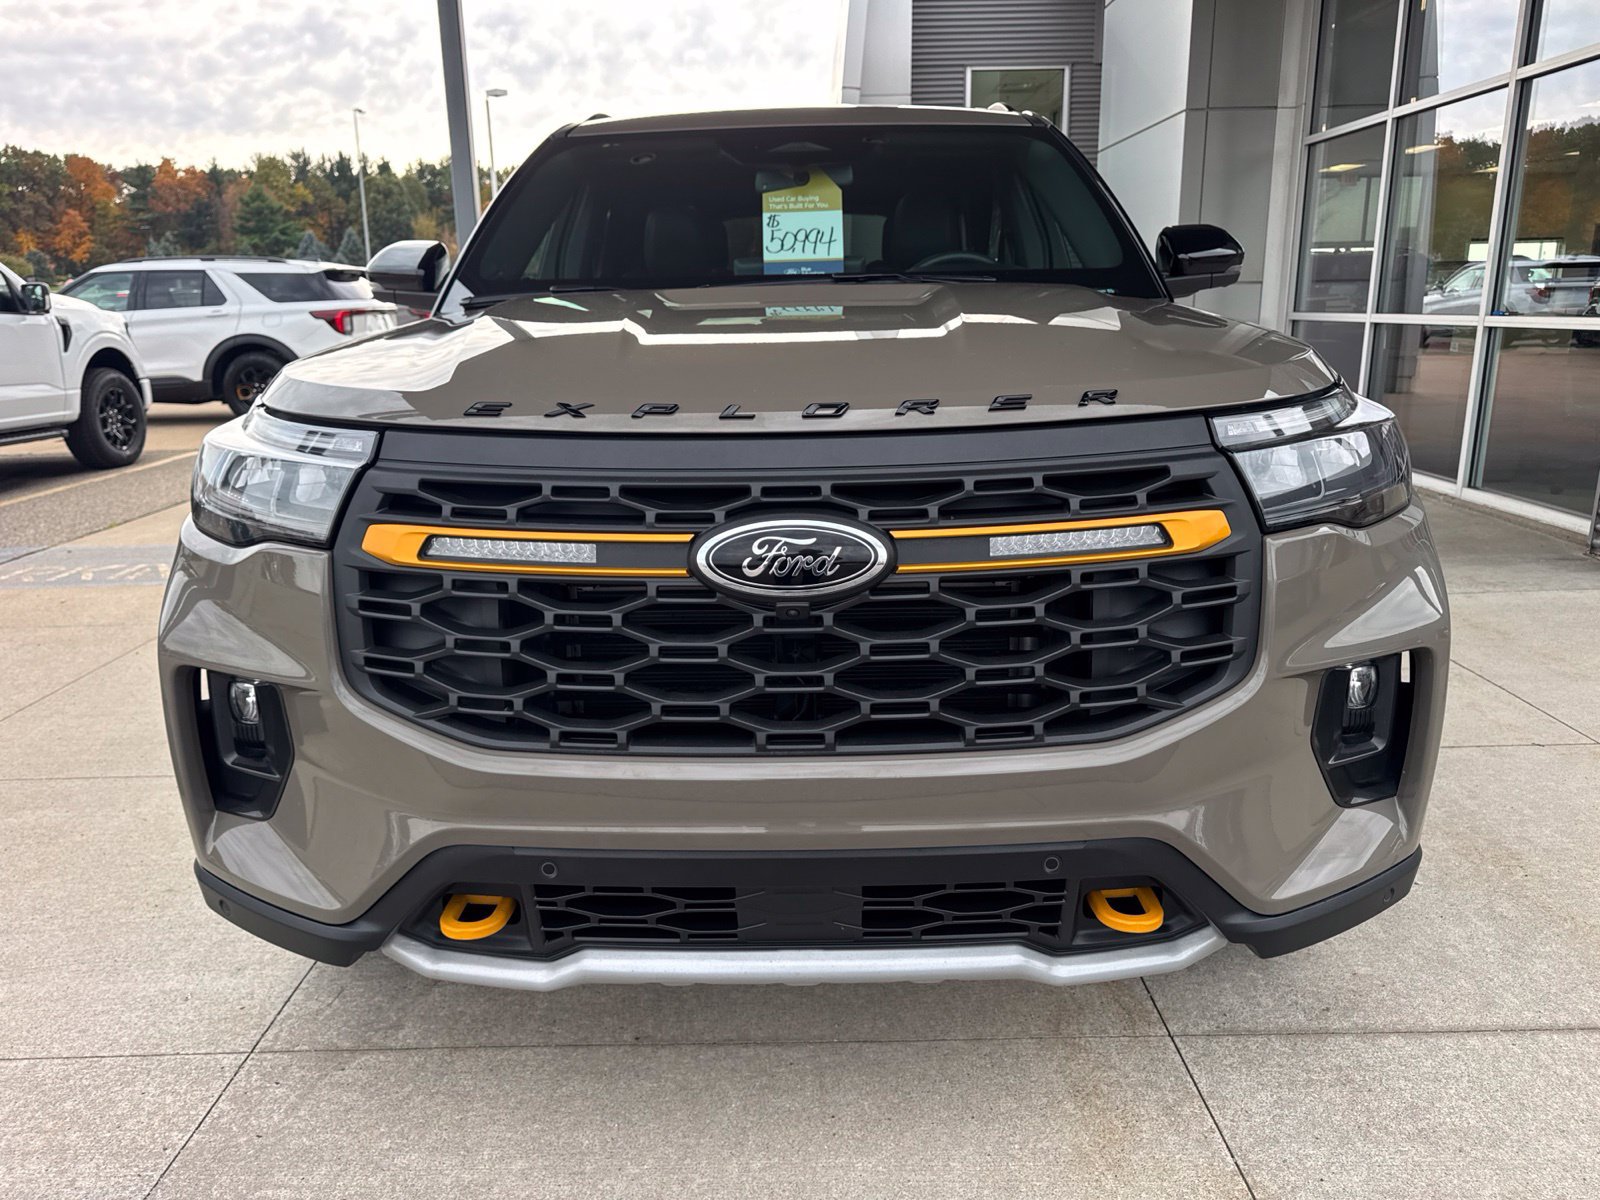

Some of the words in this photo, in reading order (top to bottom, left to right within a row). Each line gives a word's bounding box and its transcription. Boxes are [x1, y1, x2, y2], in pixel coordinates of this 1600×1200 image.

[797, 195, 819, 203] Buying
[765, 226, 837, 256] 50,994
[463, 388, 1118, 420] EXPLORER
[741, 536, 843, 577] Ford
